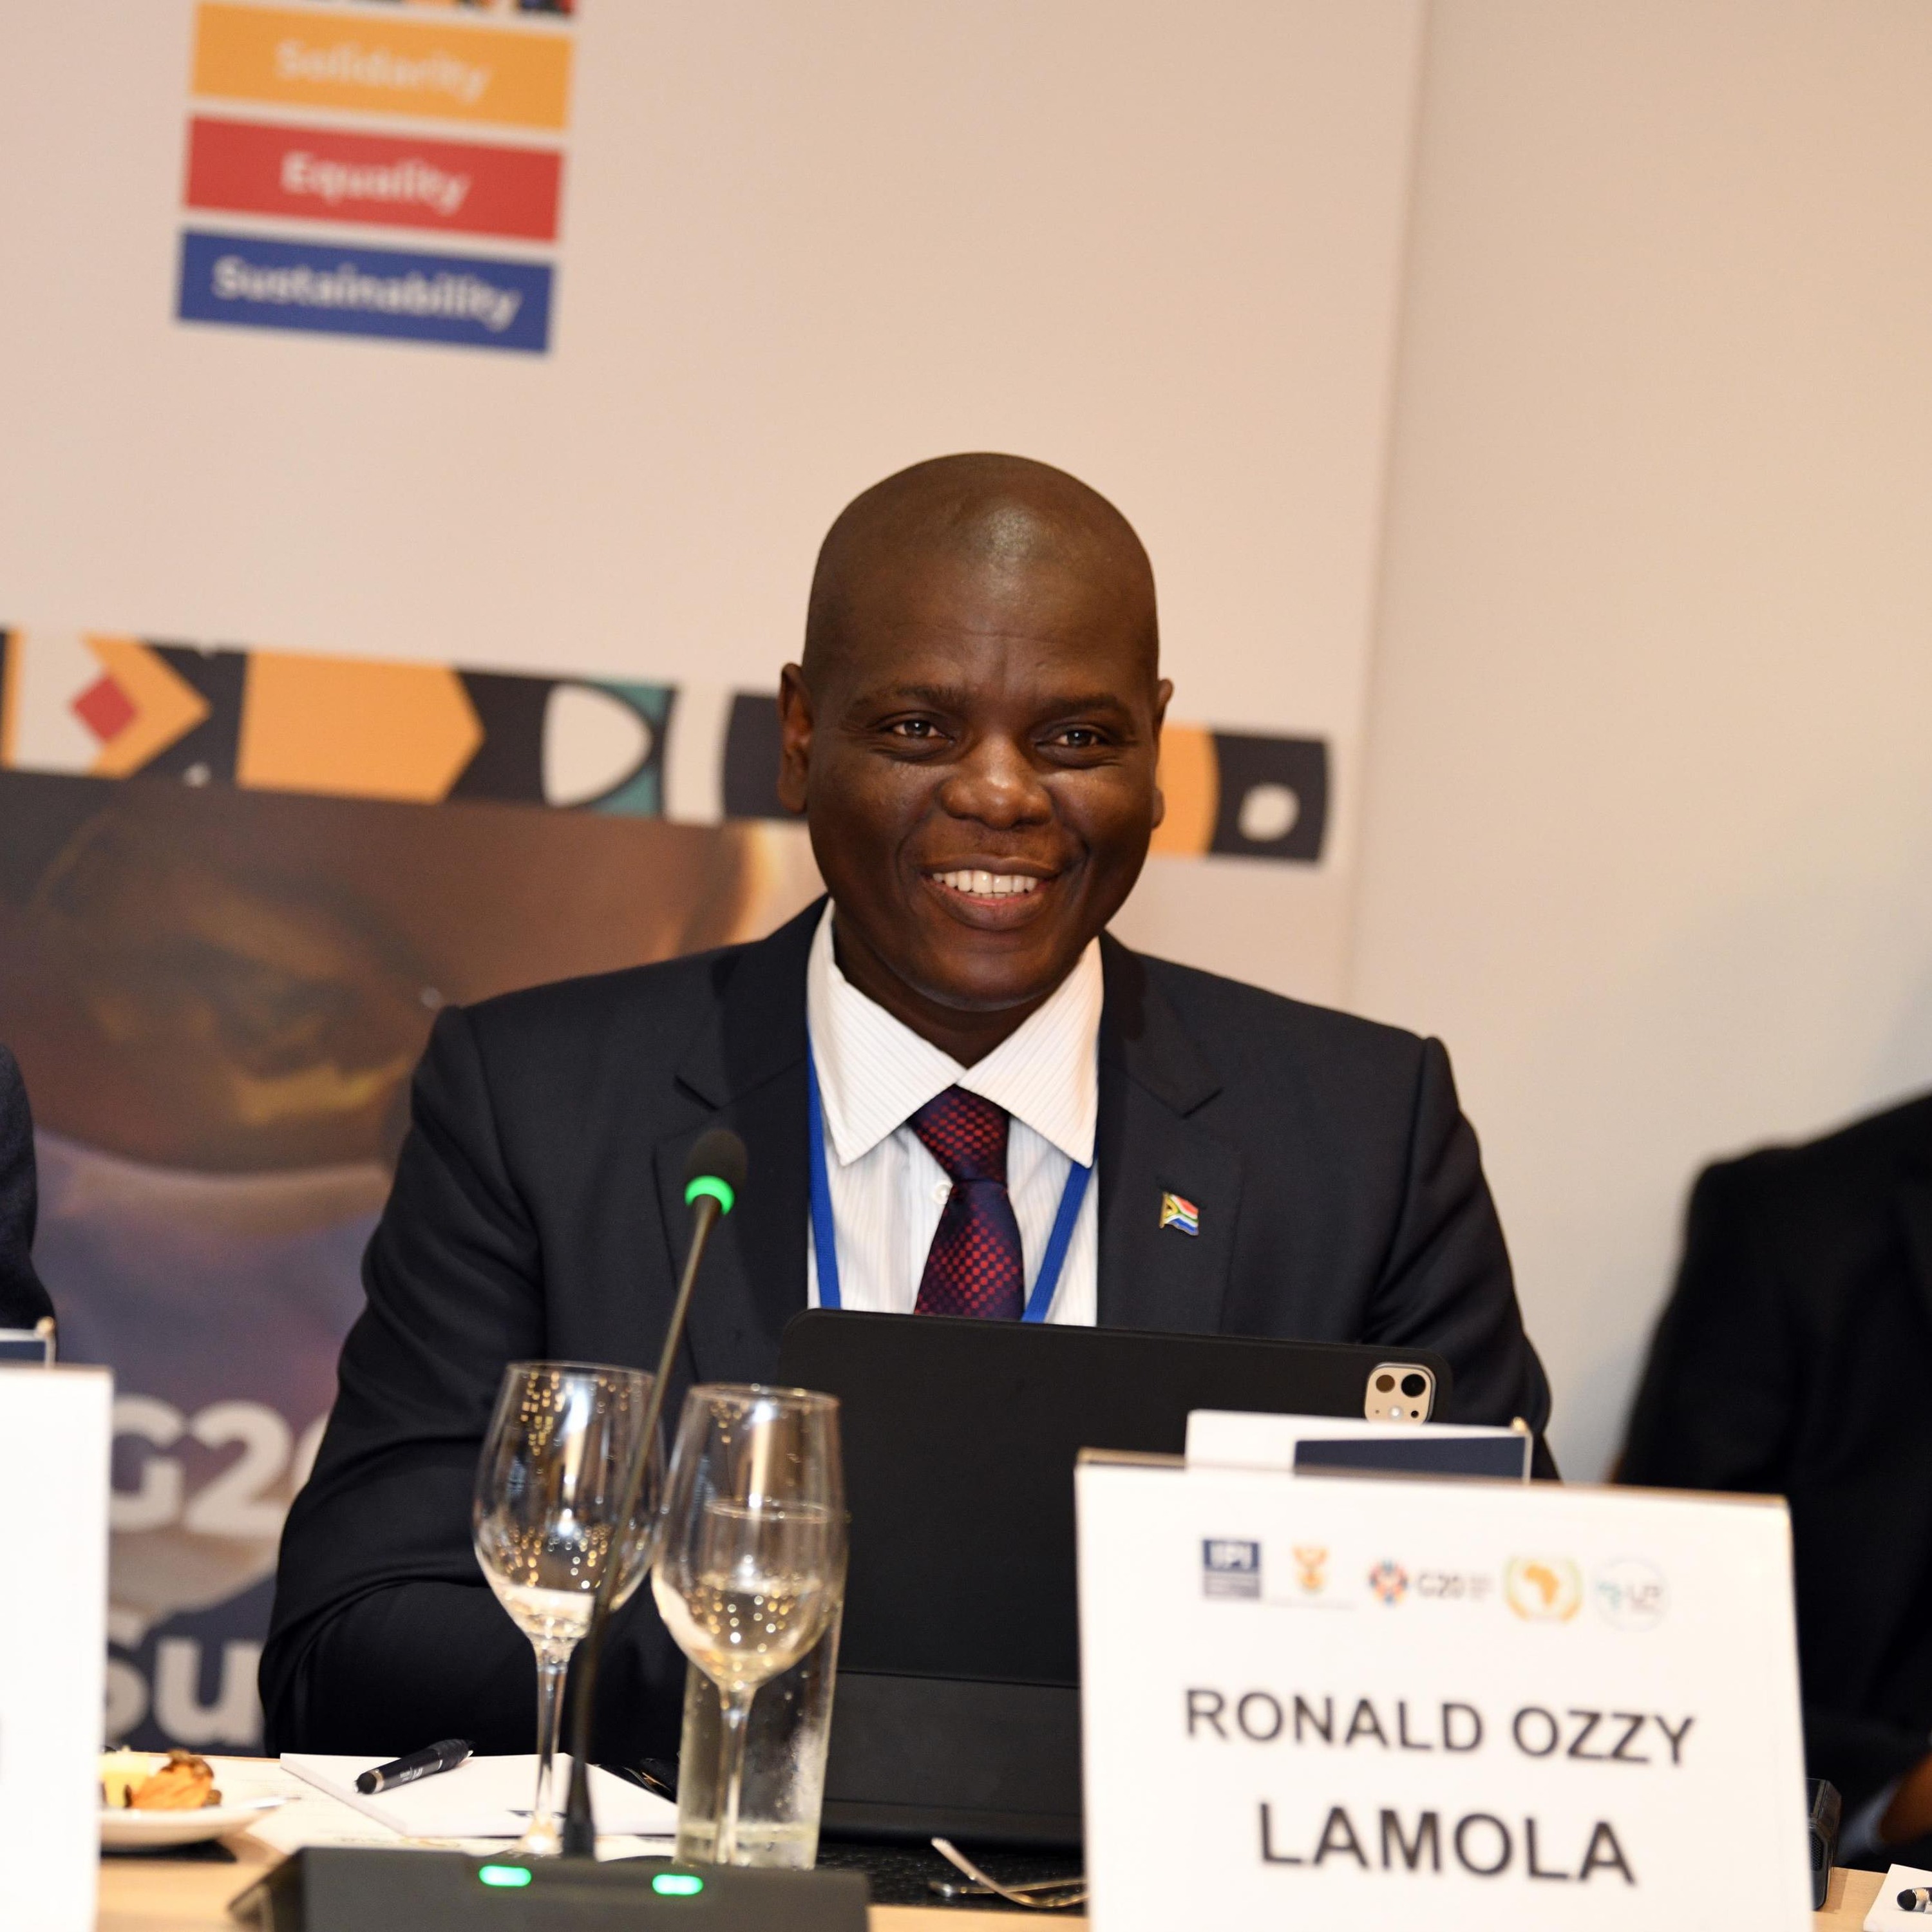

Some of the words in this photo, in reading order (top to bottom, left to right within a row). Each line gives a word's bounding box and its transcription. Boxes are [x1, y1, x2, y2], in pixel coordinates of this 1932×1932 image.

[274, 39, 491, 105] Solidarity
[280, 151, 471, 214] Equality
[213, 256, 520, 331] Sustainability
[112, 1392, 328, 1539] G2
[1185, 1687, 1484, 1753] RONALD
[1511, 1705, 1695, 1766] OZZY
[1258, 1801, 1637, 1886] LAMOLA
